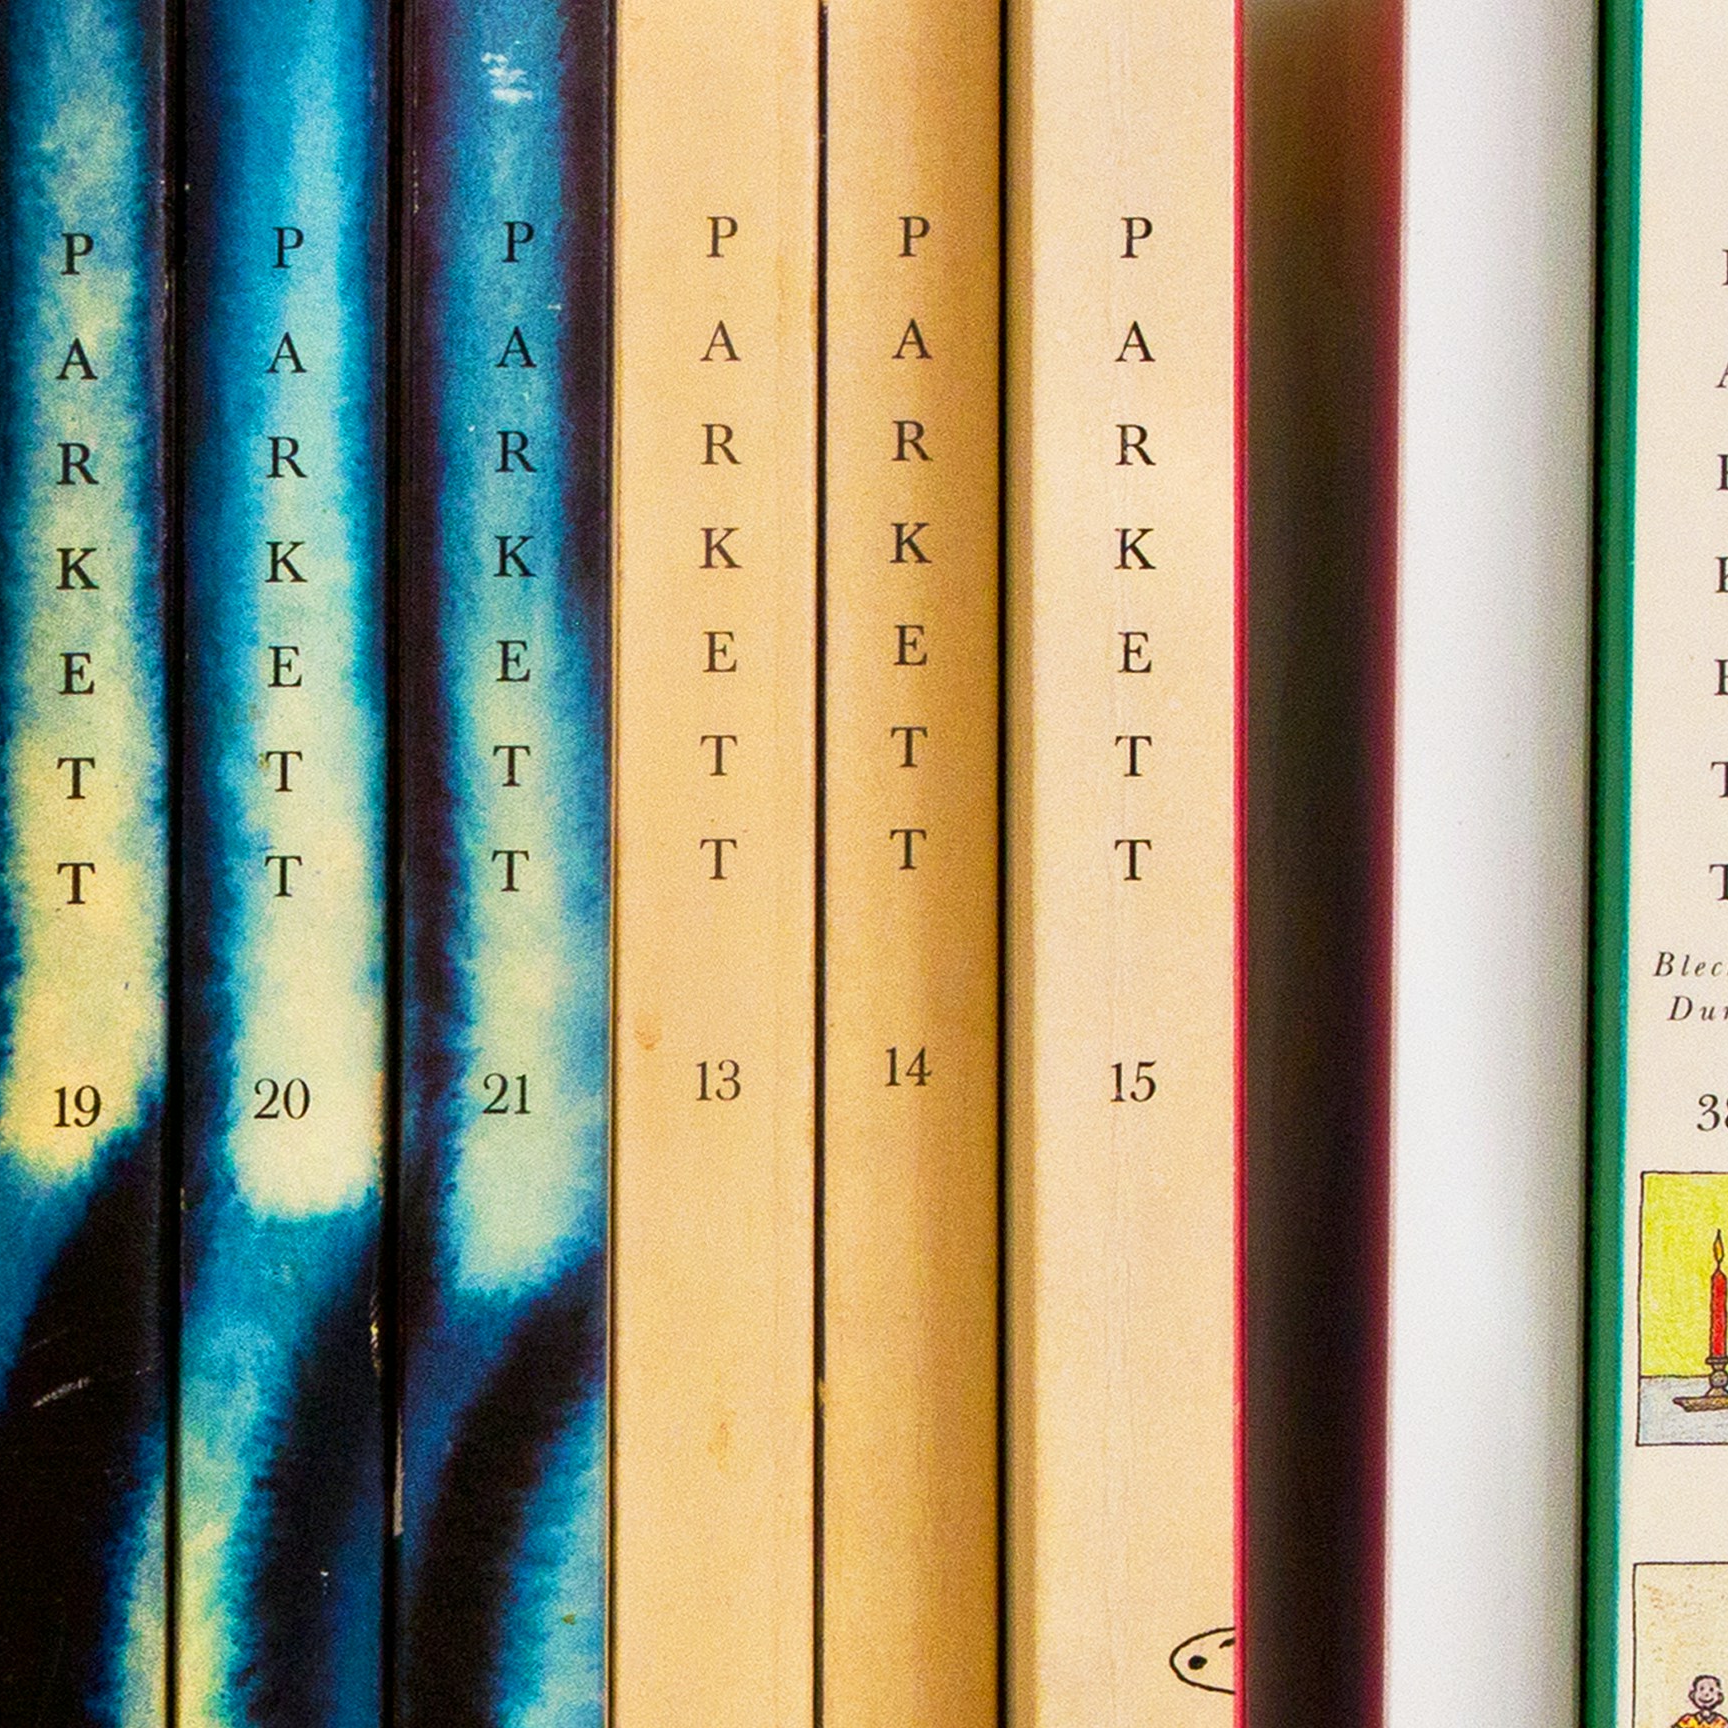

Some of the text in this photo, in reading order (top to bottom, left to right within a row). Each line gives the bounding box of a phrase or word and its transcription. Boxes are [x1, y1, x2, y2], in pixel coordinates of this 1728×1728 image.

[56, 233, 100, 906] PARKETT
[264, 227, 307, 898] PARKETT
[491, 221, 537, 893] PARKETT
[699, 216, 741, 881] PARKETT
[889, 215, 931, 871] PARKETT
[1114, 216, 1156, 881] PARKETT
[54, 1085, 102, 1128] 19
[254, 1079, 311, 1120] 20
[482, 1074, 530, 1115] 21
[697, 1060, 742, 1102] 13
[886, 1047, 931, 1087] 14
[1111, 1061, 1157, 1103] 15
